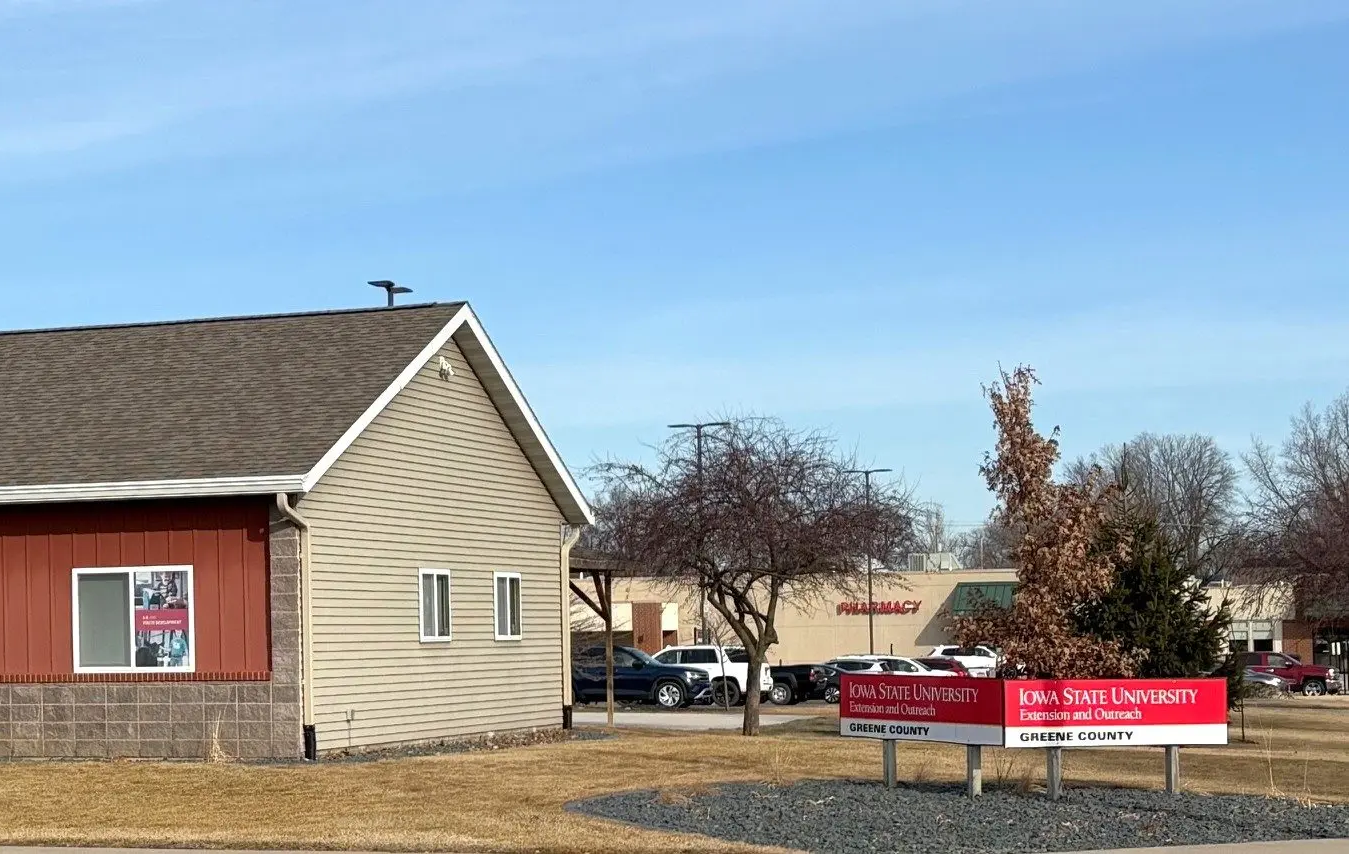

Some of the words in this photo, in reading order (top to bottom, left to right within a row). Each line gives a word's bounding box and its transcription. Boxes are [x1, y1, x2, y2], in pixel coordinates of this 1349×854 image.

[837, 600, 922, 615] PHARMACY
[849, 681, 876, 699] IOWA
[879, 682, 911, 700] STATE
[913, 684, 979, 703] UNIVERSITY
[1019, 688, 1060, 706] IOWA
[1063, 687, 1108, 705] STATE
[1111, 686, 1199, 705] UNIVERSITY
[849, 701, 885, 714] Extension
[885, 702, 900, 714] and
[900, 703, 936, 716] Outreach
[1019, 708, 1071, 721] Extension
[1073, 707, 1093, 721] and
[1094, 706, 1143, 720] Outreach
[850, 723, 886, 734] GREENE
[890, 725, 930, 736] COUNTY
[1020, 731, 1074, 742] GREENE
[1078, 731, 1134, 741] COUNTY
